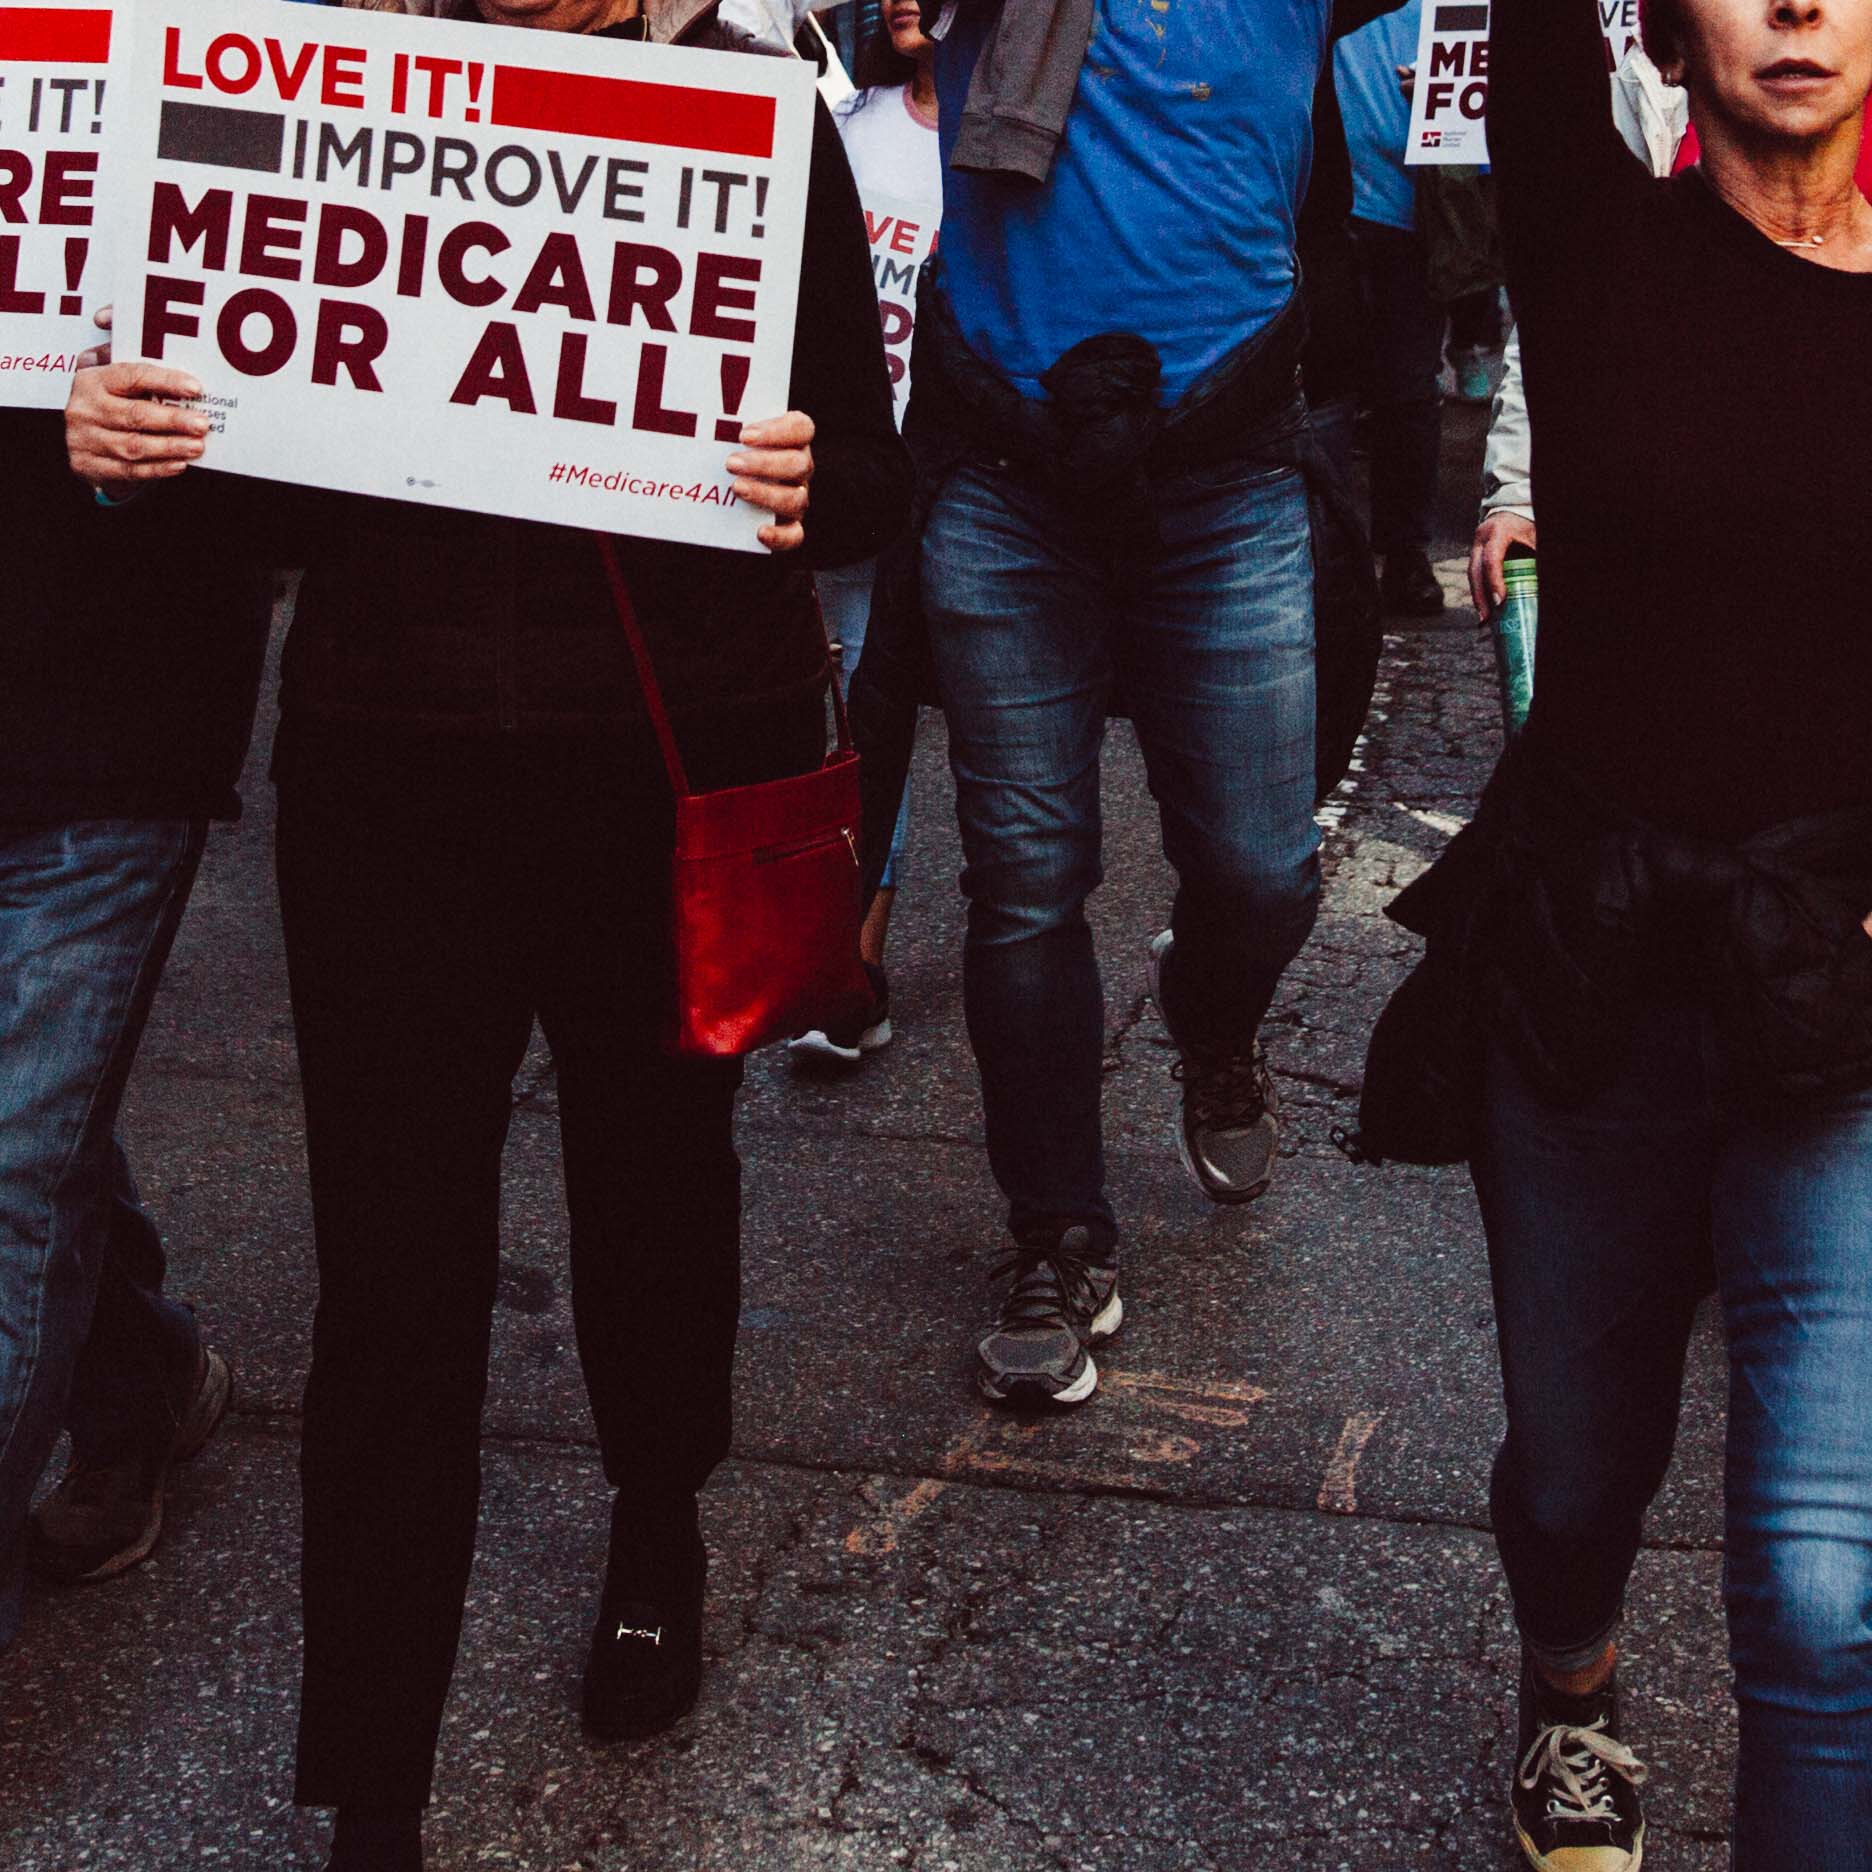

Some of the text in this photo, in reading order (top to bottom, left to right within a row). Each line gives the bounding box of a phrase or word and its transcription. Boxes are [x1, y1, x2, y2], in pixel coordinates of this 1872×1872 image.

[28, 77, 106, 134] IT!
[162, 25, 486, 123] LOVE IT!
[1425, 82, 1488, 120] FO
[292, 118, 770, 239] IMPROVE IT!
[146, 181, 764, 343] MEDICARE
[865, 209, 920, 255] VE
[140, 273, 751, 443] FOR ALL!
[194, 394, 238, 408] ational
